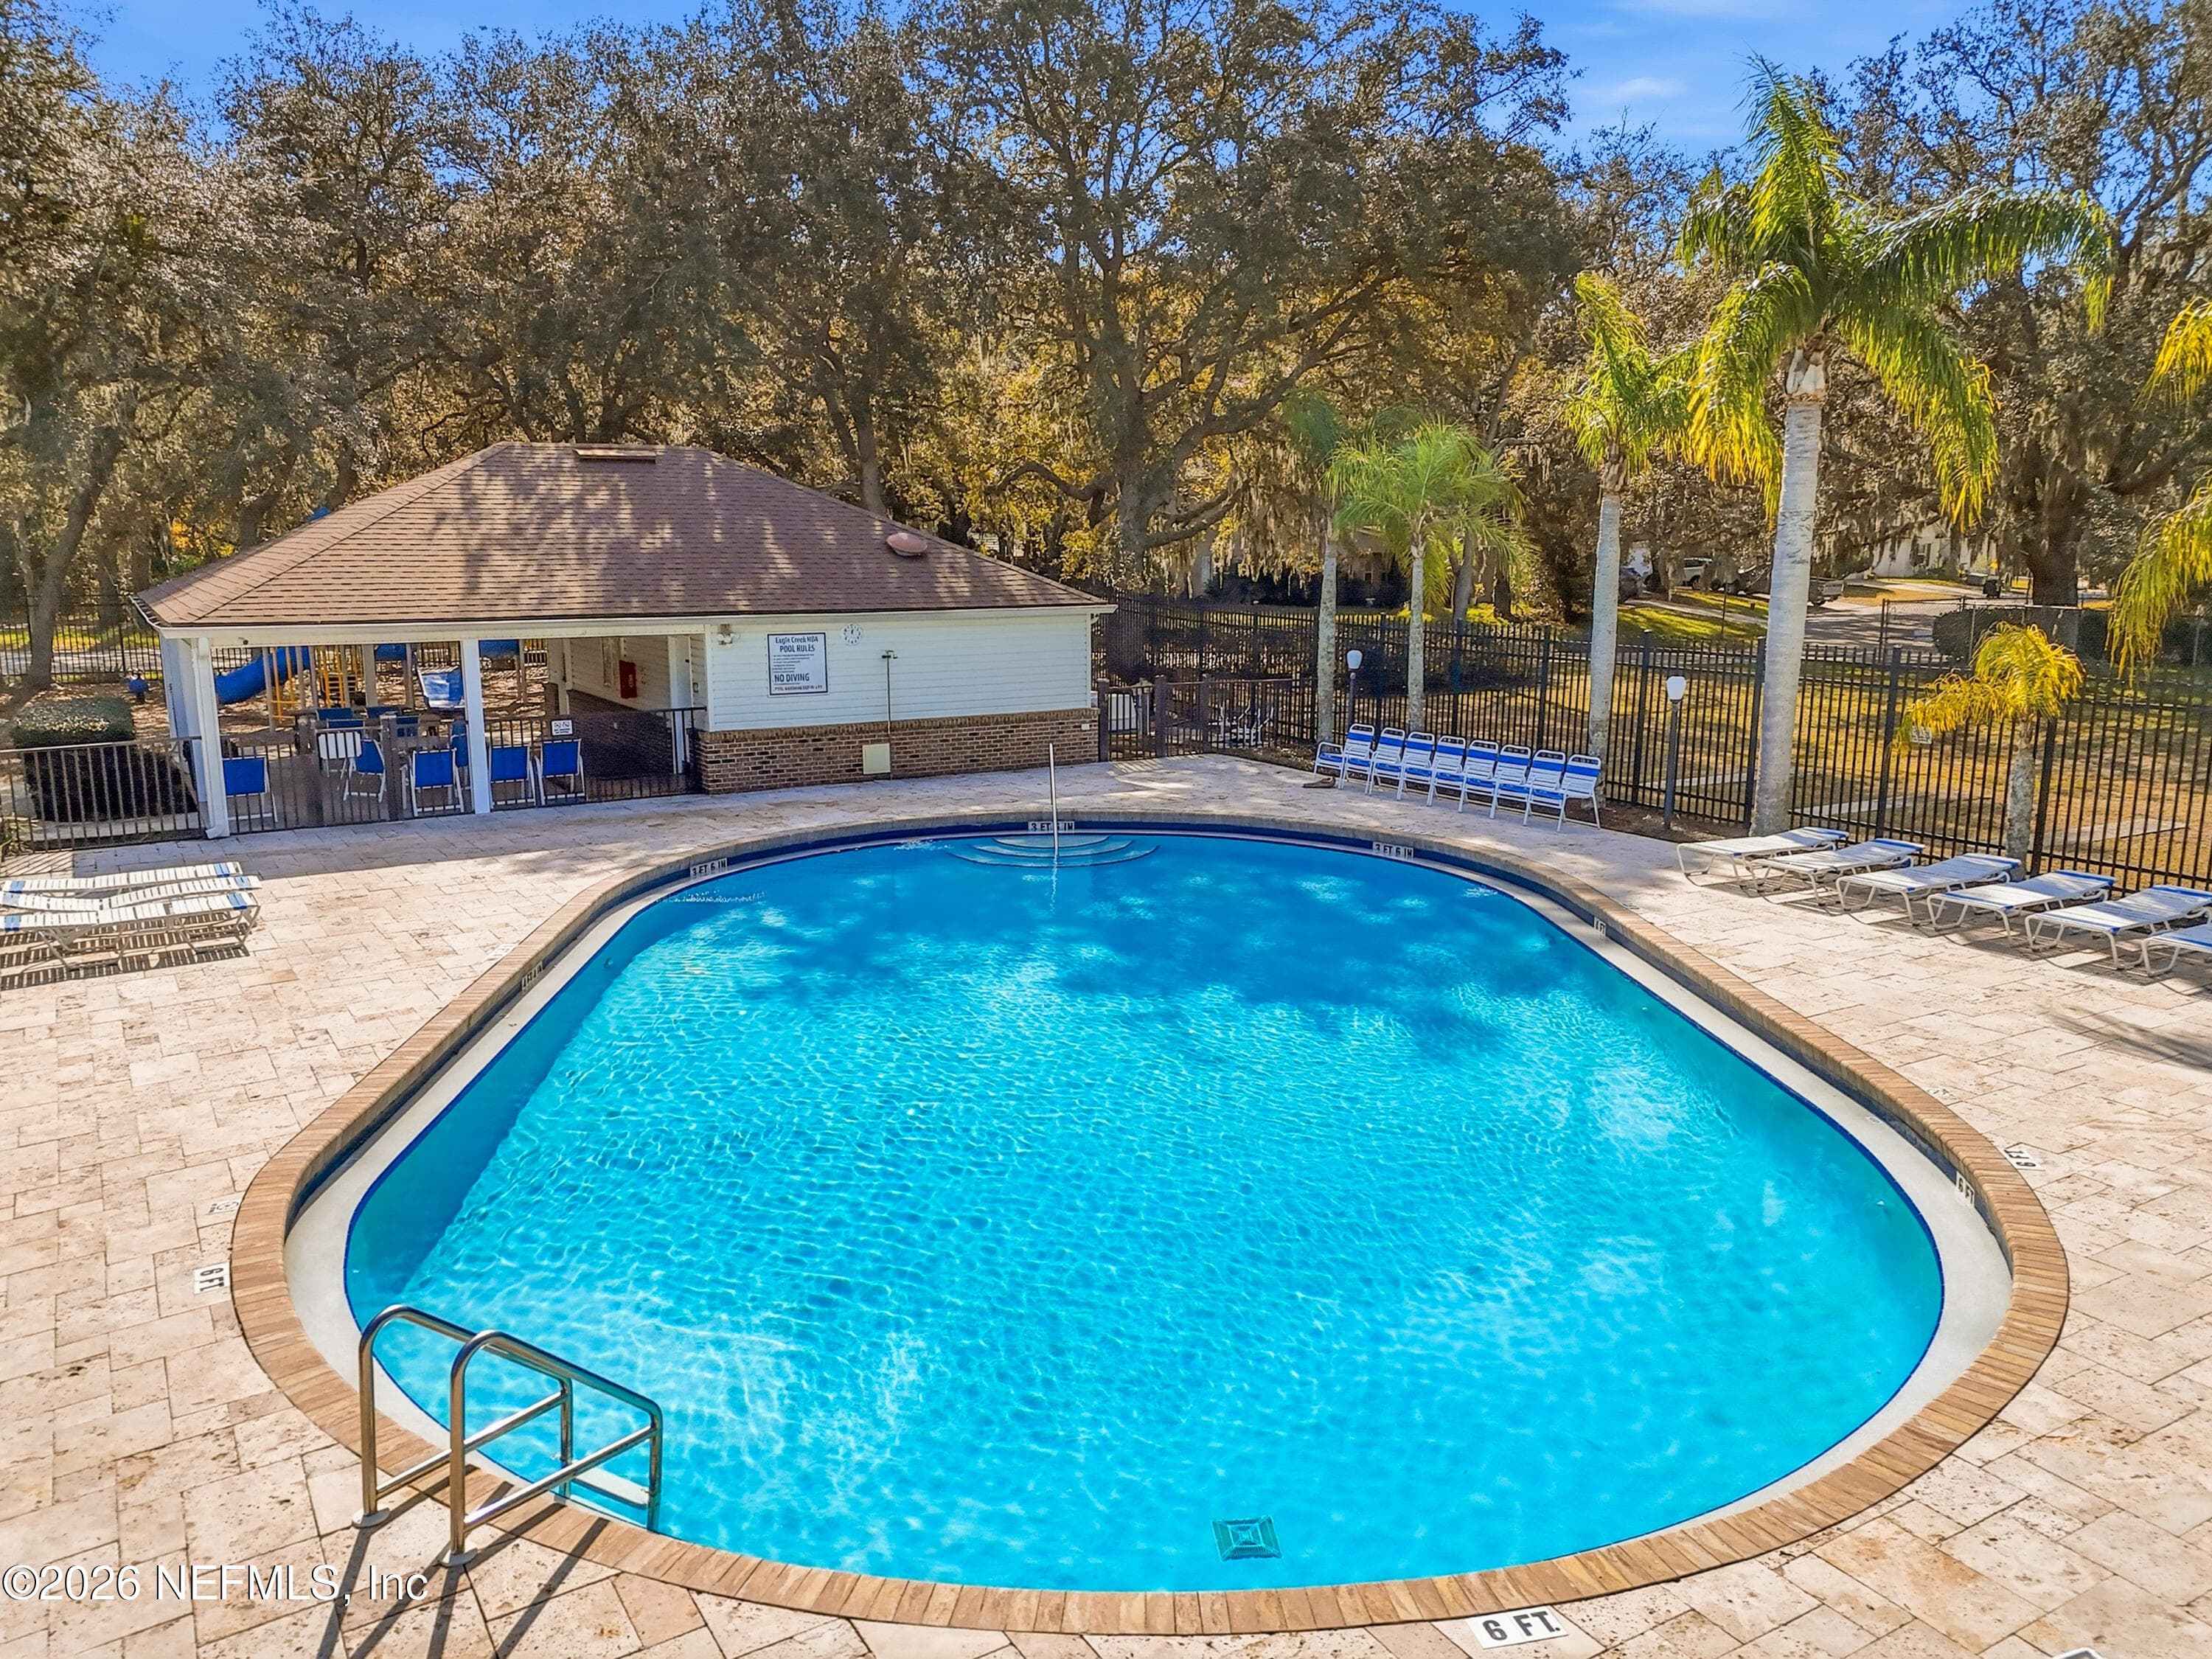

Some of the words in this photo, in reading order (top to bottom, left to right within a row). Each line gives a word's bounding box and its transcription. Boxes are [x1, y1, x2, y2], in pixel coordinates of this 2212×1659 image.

[779, 644, 796, 653] POOL
[796, 644, 815, 652] RULES
[774, 674, 785, 682] NO
[786, 672, 810, 682] DIVING
[1031, 822, 1037, 832] 3
[1958, 1178, 1964, 1192] 6
[1965, 1186, 1974, 1204] FT
[200, 1267, 224, 1276] 6
[1482, 1619, 1508, 1641] 6
[1512, 1610, 1561, 1636] FT.
